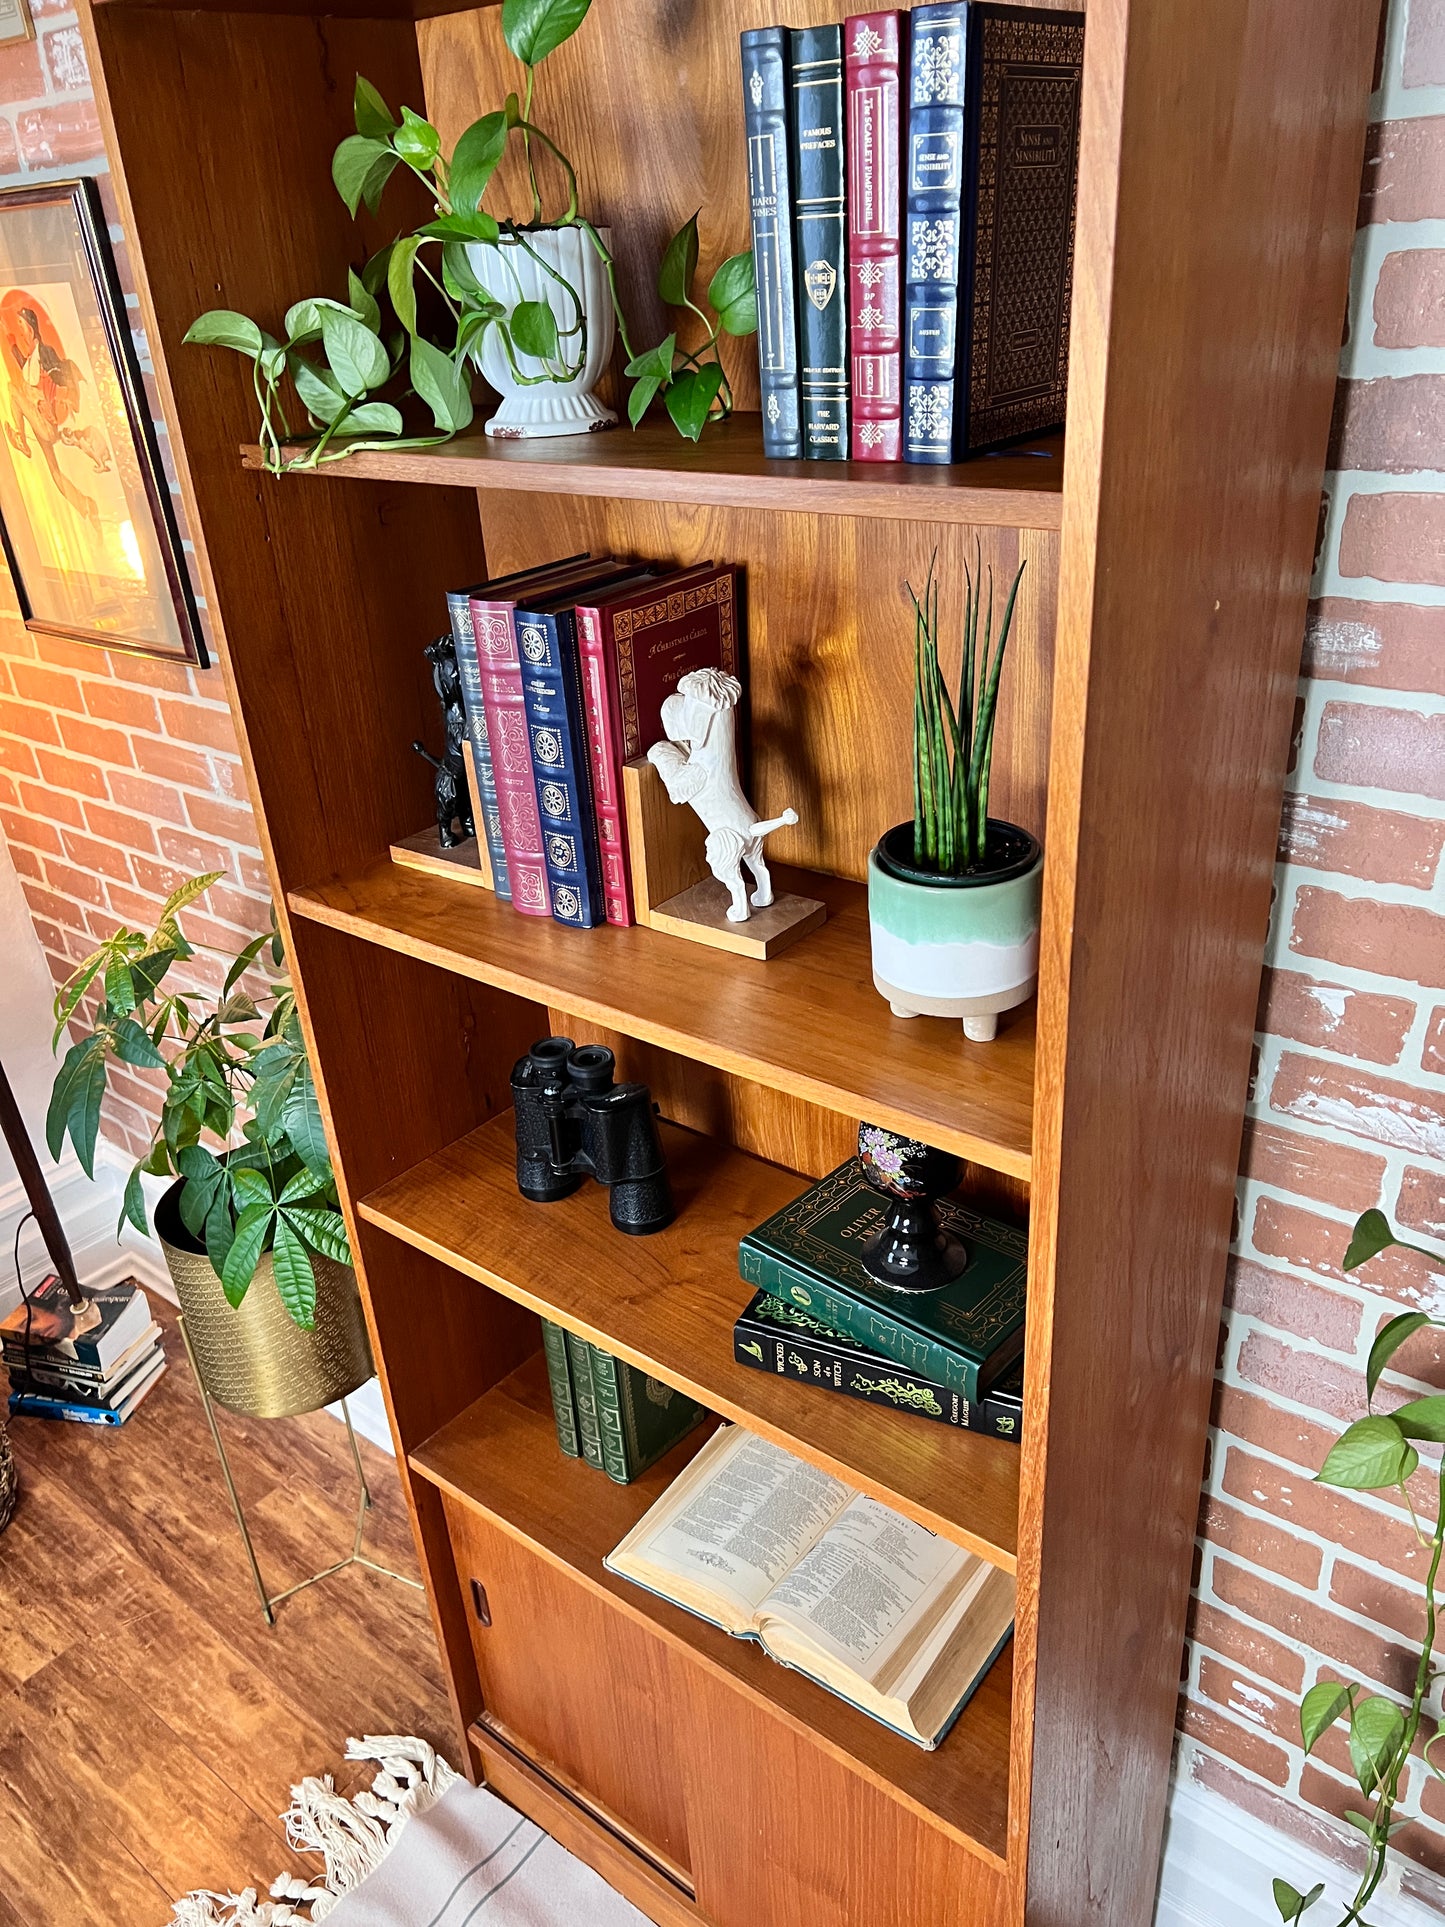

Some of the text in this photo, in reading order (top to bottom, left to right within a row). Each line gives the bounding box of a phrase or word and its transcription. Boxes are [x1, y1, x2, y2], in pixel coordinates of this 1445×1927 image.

[803, 127, 832, 137] FAMOUS
[800, 139, 836, 151] PREFACES
[864, 117, 873, 164] SCARLET
[918, 153, 937, 162] SENSE
[752, 196, 777, 207] HARD
[864, 165, 873, 224] PIMPERNEL
[752, 206, 778, 218] TIMES
[863, 292, 876, 301] DP
[866, 362, 874, 392] ORCZY
[816, 410, 830, 418] THE
[808, 422, 840, 431] HARVARD
[809, 435, 839, 443] CLASSICS
[840, 1207, 882, 1238] OLIVER
[855, 1215, 887, 1242] TWIST
[776, 1342, 785, 1373] WICKED
[813, 1359, 821, 1378] SON
[833, 1361, 842, 1387] WITCH
[950, 1393, 959, 1424] GREGORY
